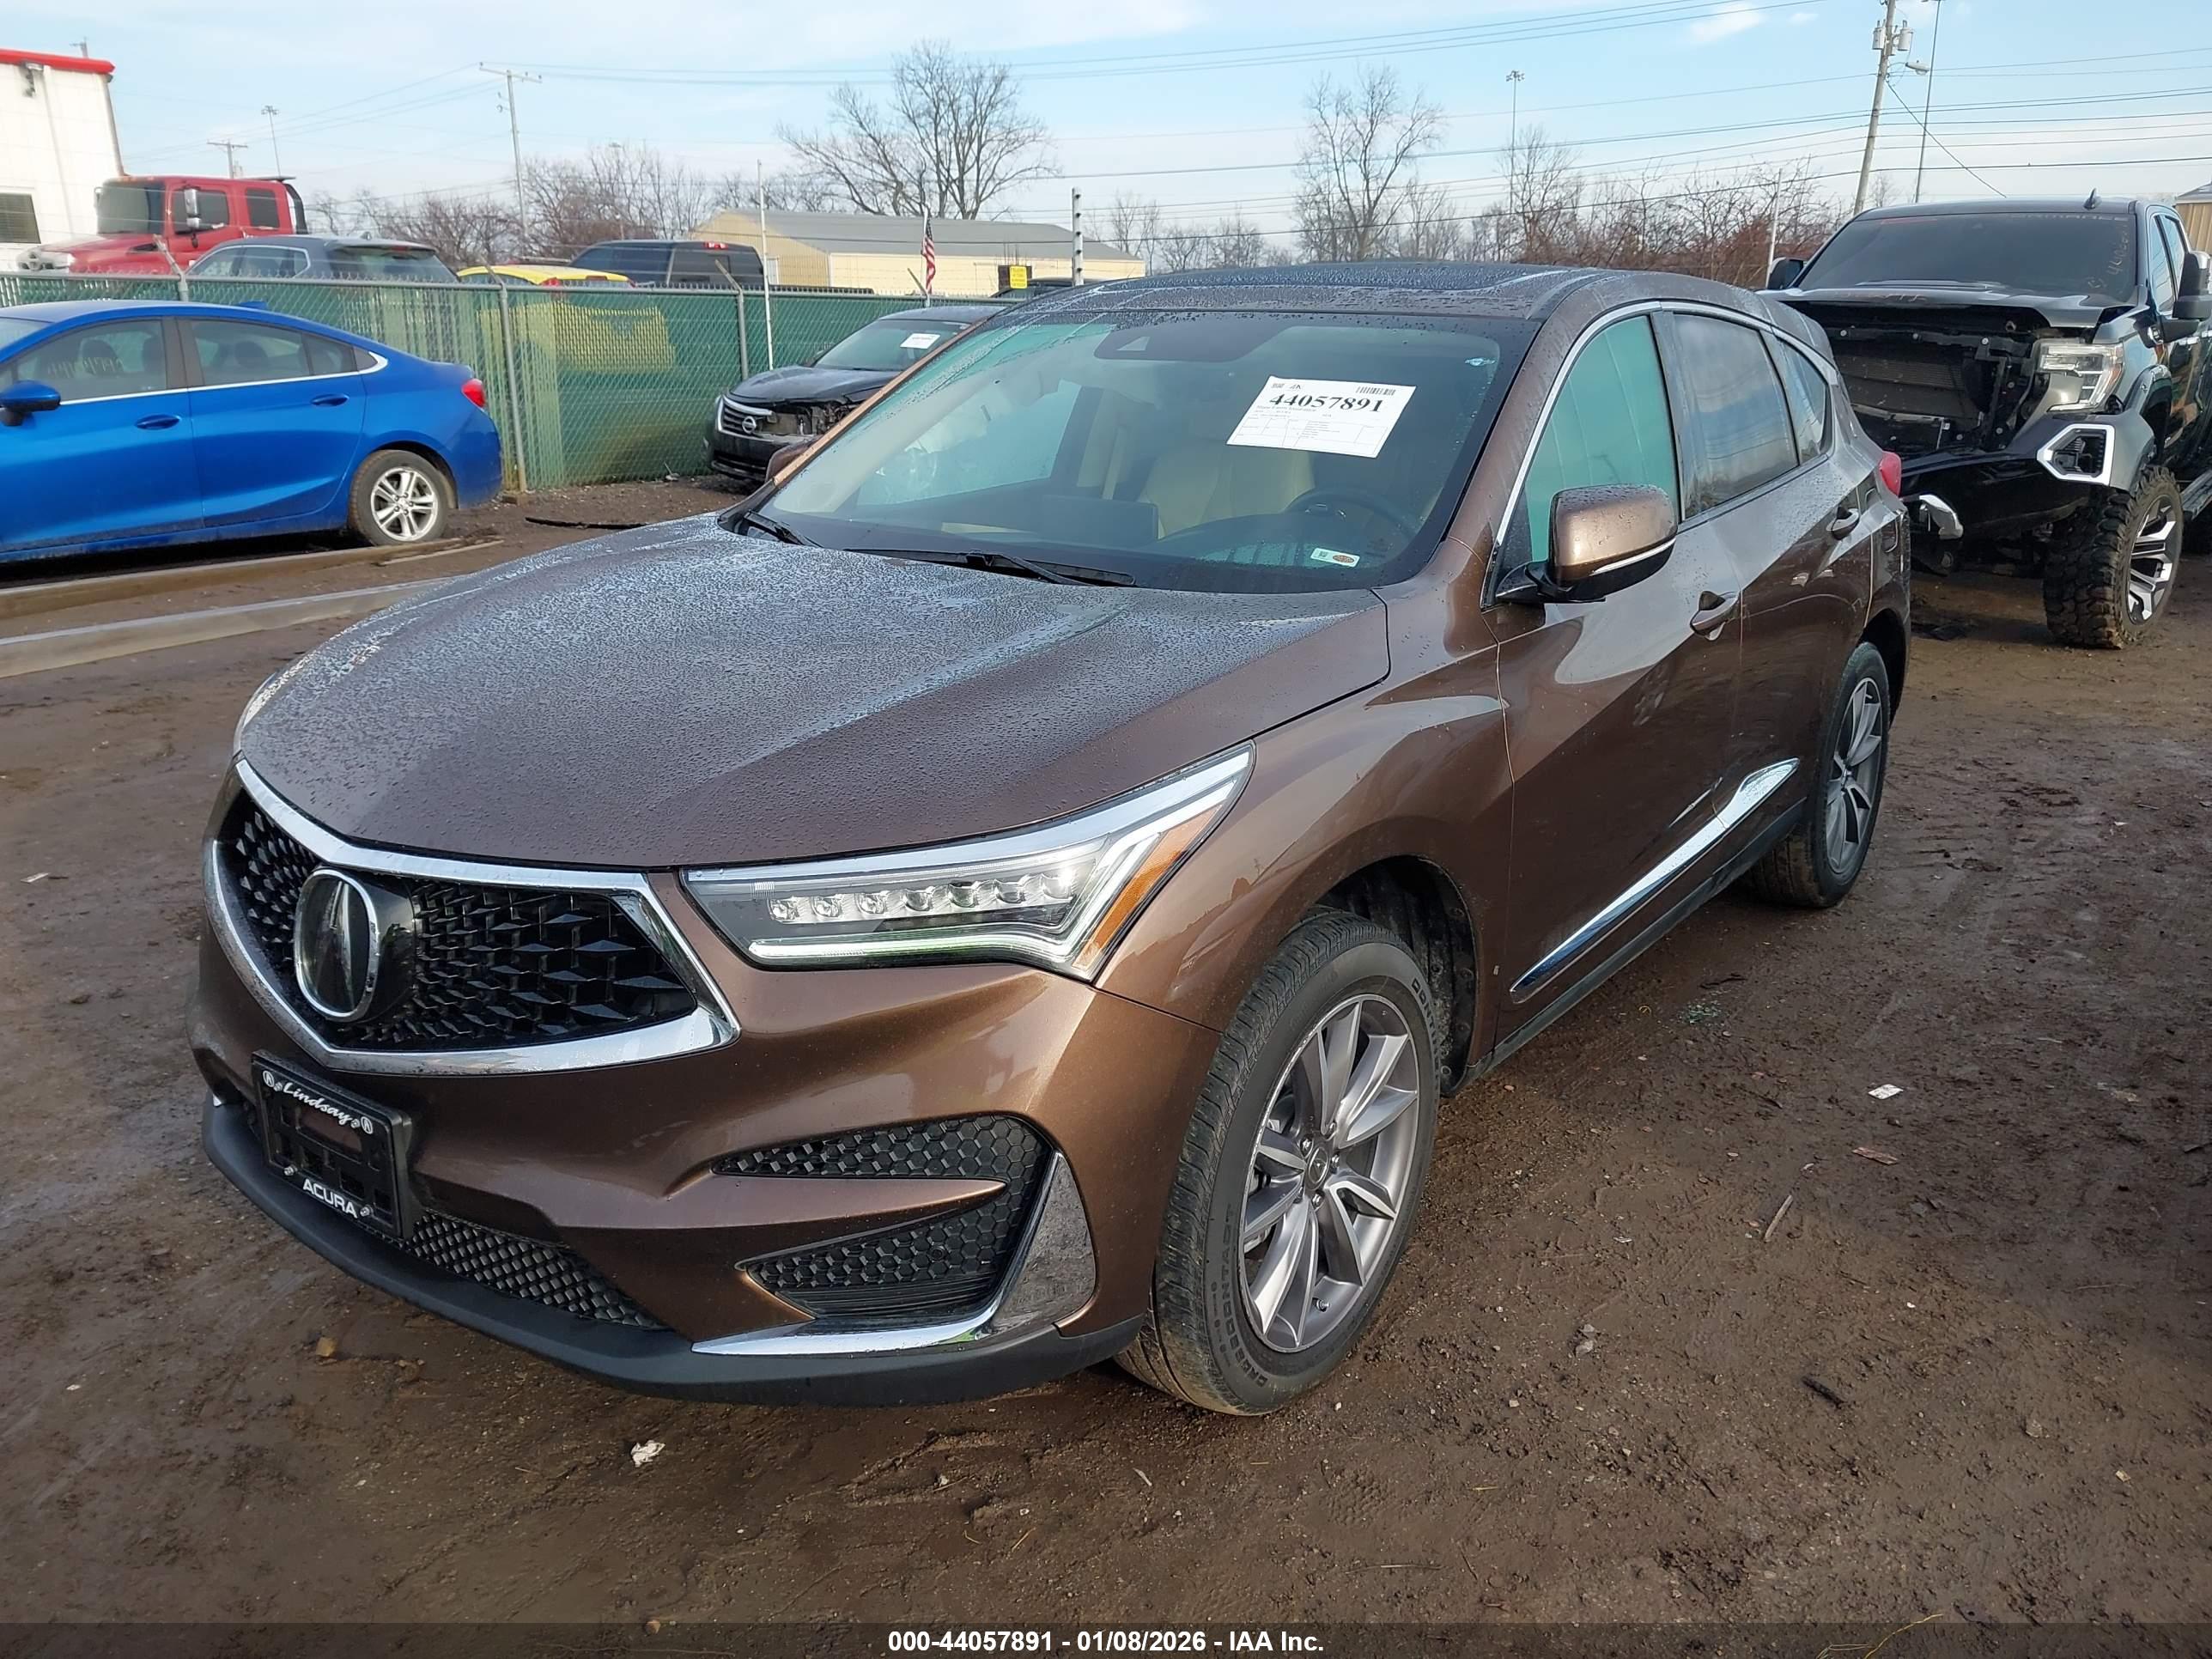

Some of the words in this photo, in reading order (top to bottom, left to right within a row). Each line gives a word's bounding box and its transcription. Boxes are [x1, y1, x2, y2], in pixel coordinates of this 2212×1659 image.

[1269, 393, 1384, 413] 44057891
[283, 1081, 353, 1126] Lindsay
[302, 1178, 358, 1219] ACURA
